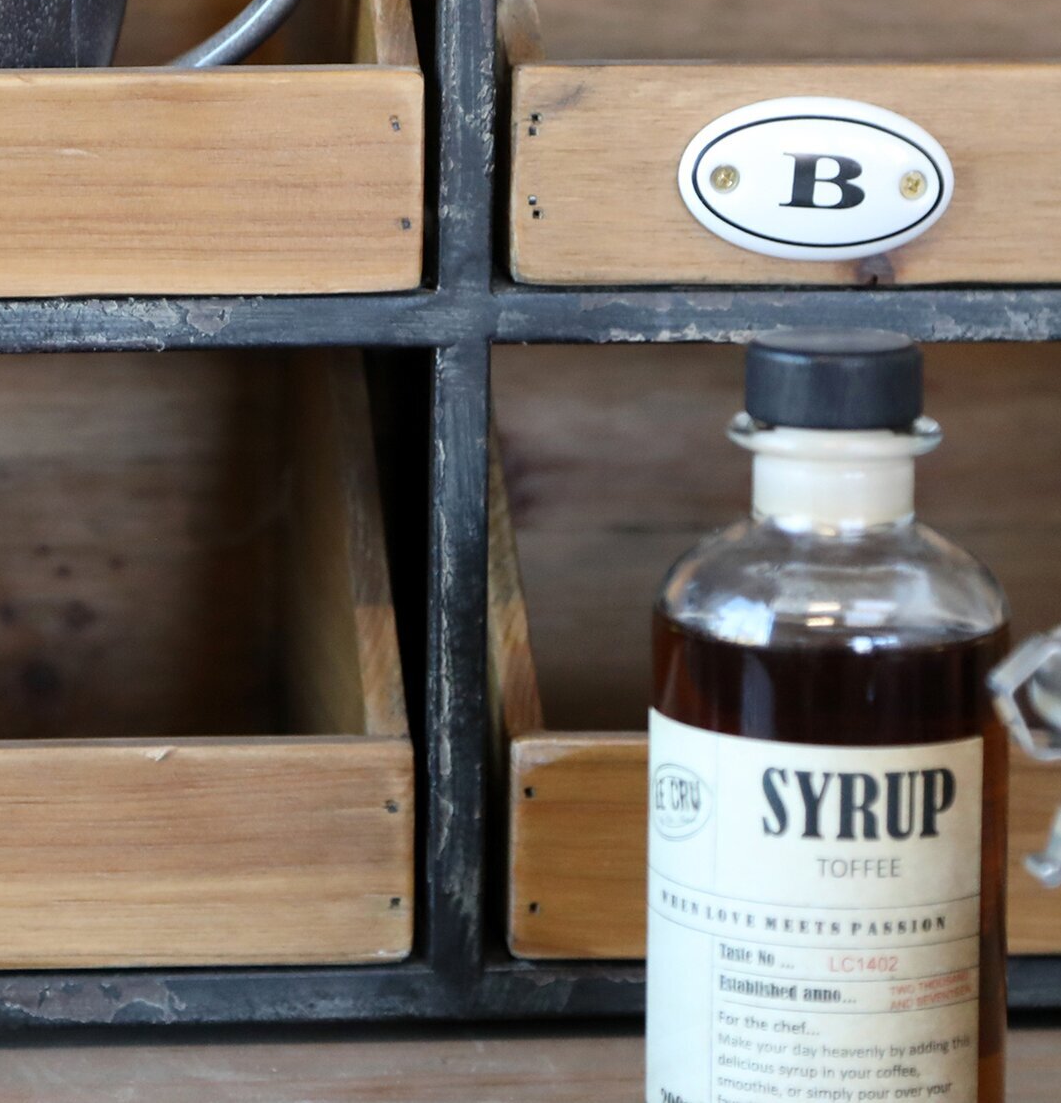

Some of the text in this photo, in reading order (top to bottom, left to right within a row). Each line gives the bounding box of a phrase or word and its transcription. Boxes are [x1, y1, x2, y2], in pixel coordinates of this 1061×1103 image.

[779, 153, 865, 209] B
[762, 767, 957, 840] SYRUP
[816, 857, 902, 879] TOFFEE
[706, 905, 756, 928] LOVE
[765, 917, 840, 935] MEETS
[851, 916, 946, 935] PASSION
[757, 949, 776, 967] No
[828, 955, 899, 973] LC1402
[719, 973, 856, 1004] Established anno...
[718, 1010, 820, 1036] For the chef...
[718, 1032, 752, 1047] Make
[757, 1042, 788, 1055] your
[792, 1043, 817, 1058] day
[823, 1045, 885, 1059] heavenly
[890, 1045, 904, 1058] by
[909, 1040, 949, 1055] adding
[718, 1054, 921, 1081] delicious syrup in your coffee,
[717, 1076, 953, 1101] smoothie, or simply pour over your
